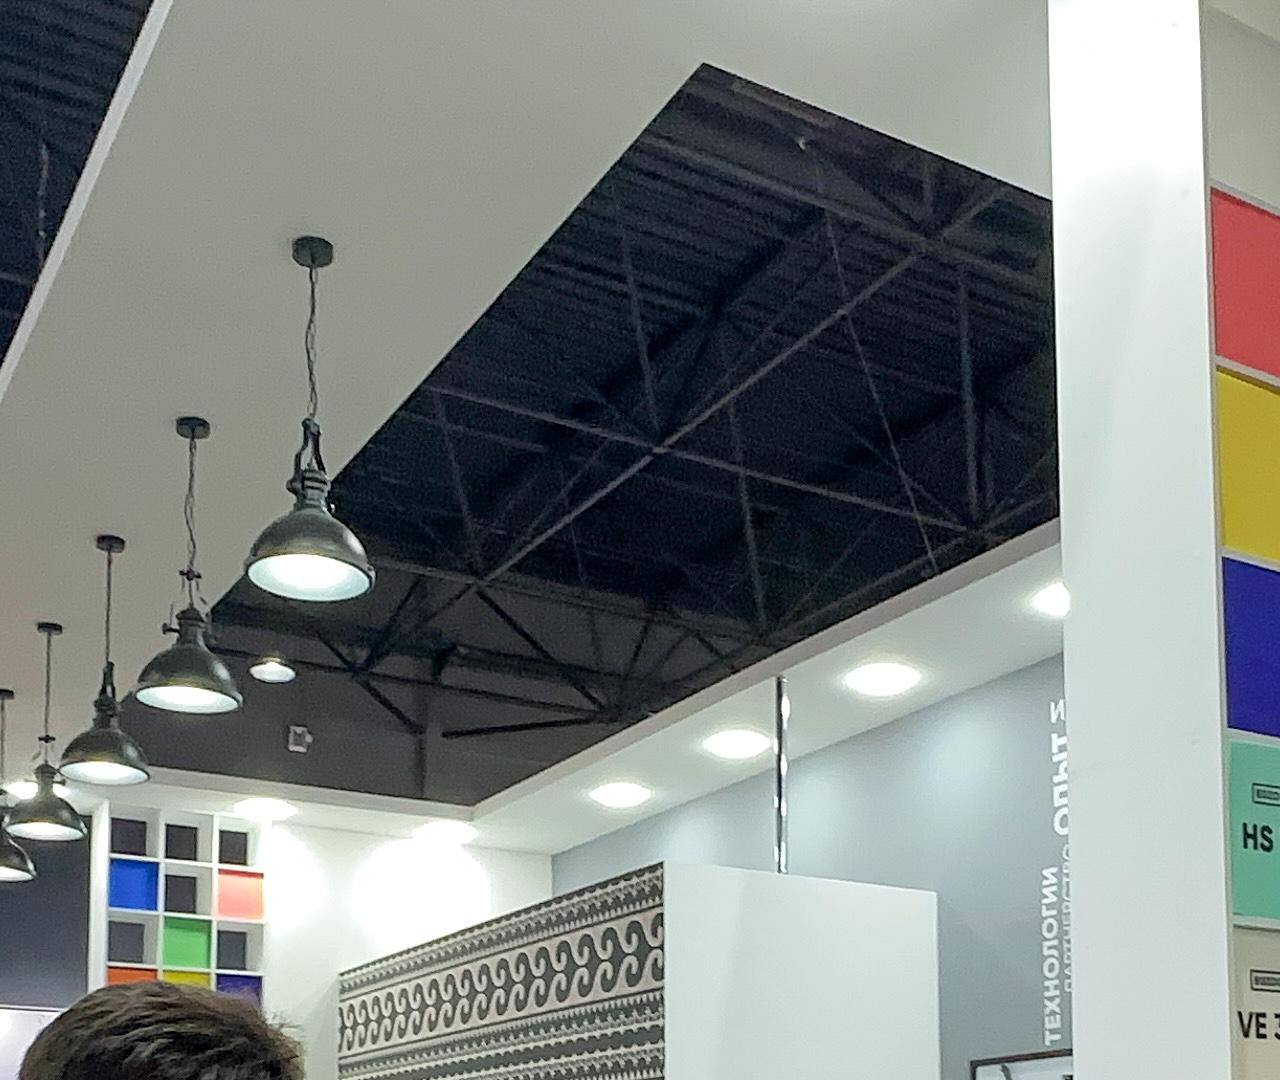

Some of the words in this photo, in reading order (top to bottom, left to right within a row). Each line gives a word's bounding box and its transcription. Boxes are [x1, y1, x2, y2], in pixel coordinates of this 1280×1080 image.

[1242, 822, 1274, 853] HS
[1041, 866, 1062, 1046] ТЕХНОЛОГИИ
[1237, 1011, 1268, 1040] VE
